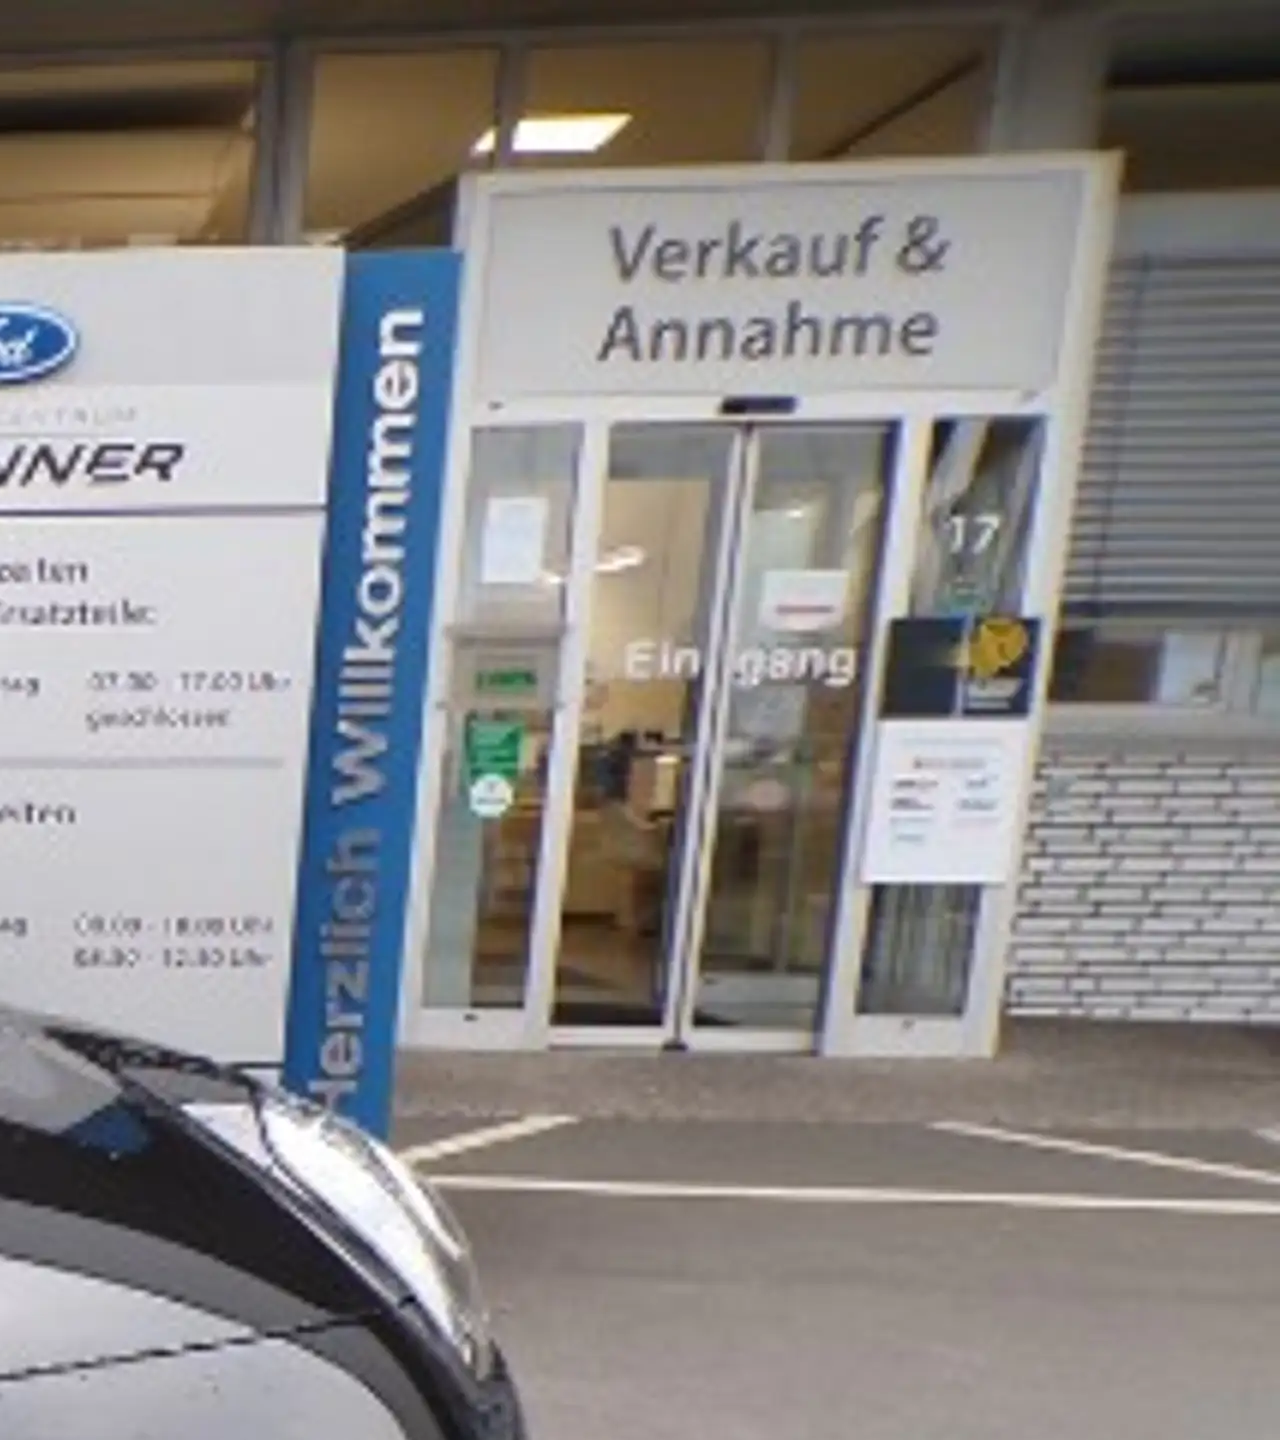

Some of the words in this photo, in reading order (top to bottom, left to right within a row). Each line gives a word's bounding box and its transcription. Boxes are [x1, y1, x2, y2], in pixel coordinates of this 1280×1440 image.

[608, 214, 883, 284] Verkauf
[896, 214, 951, 275] &
[597, 300, 939, 362] Annahme
[332, 307, 424, 804] Willkommen
[949, 514, 1000, 554] 17
